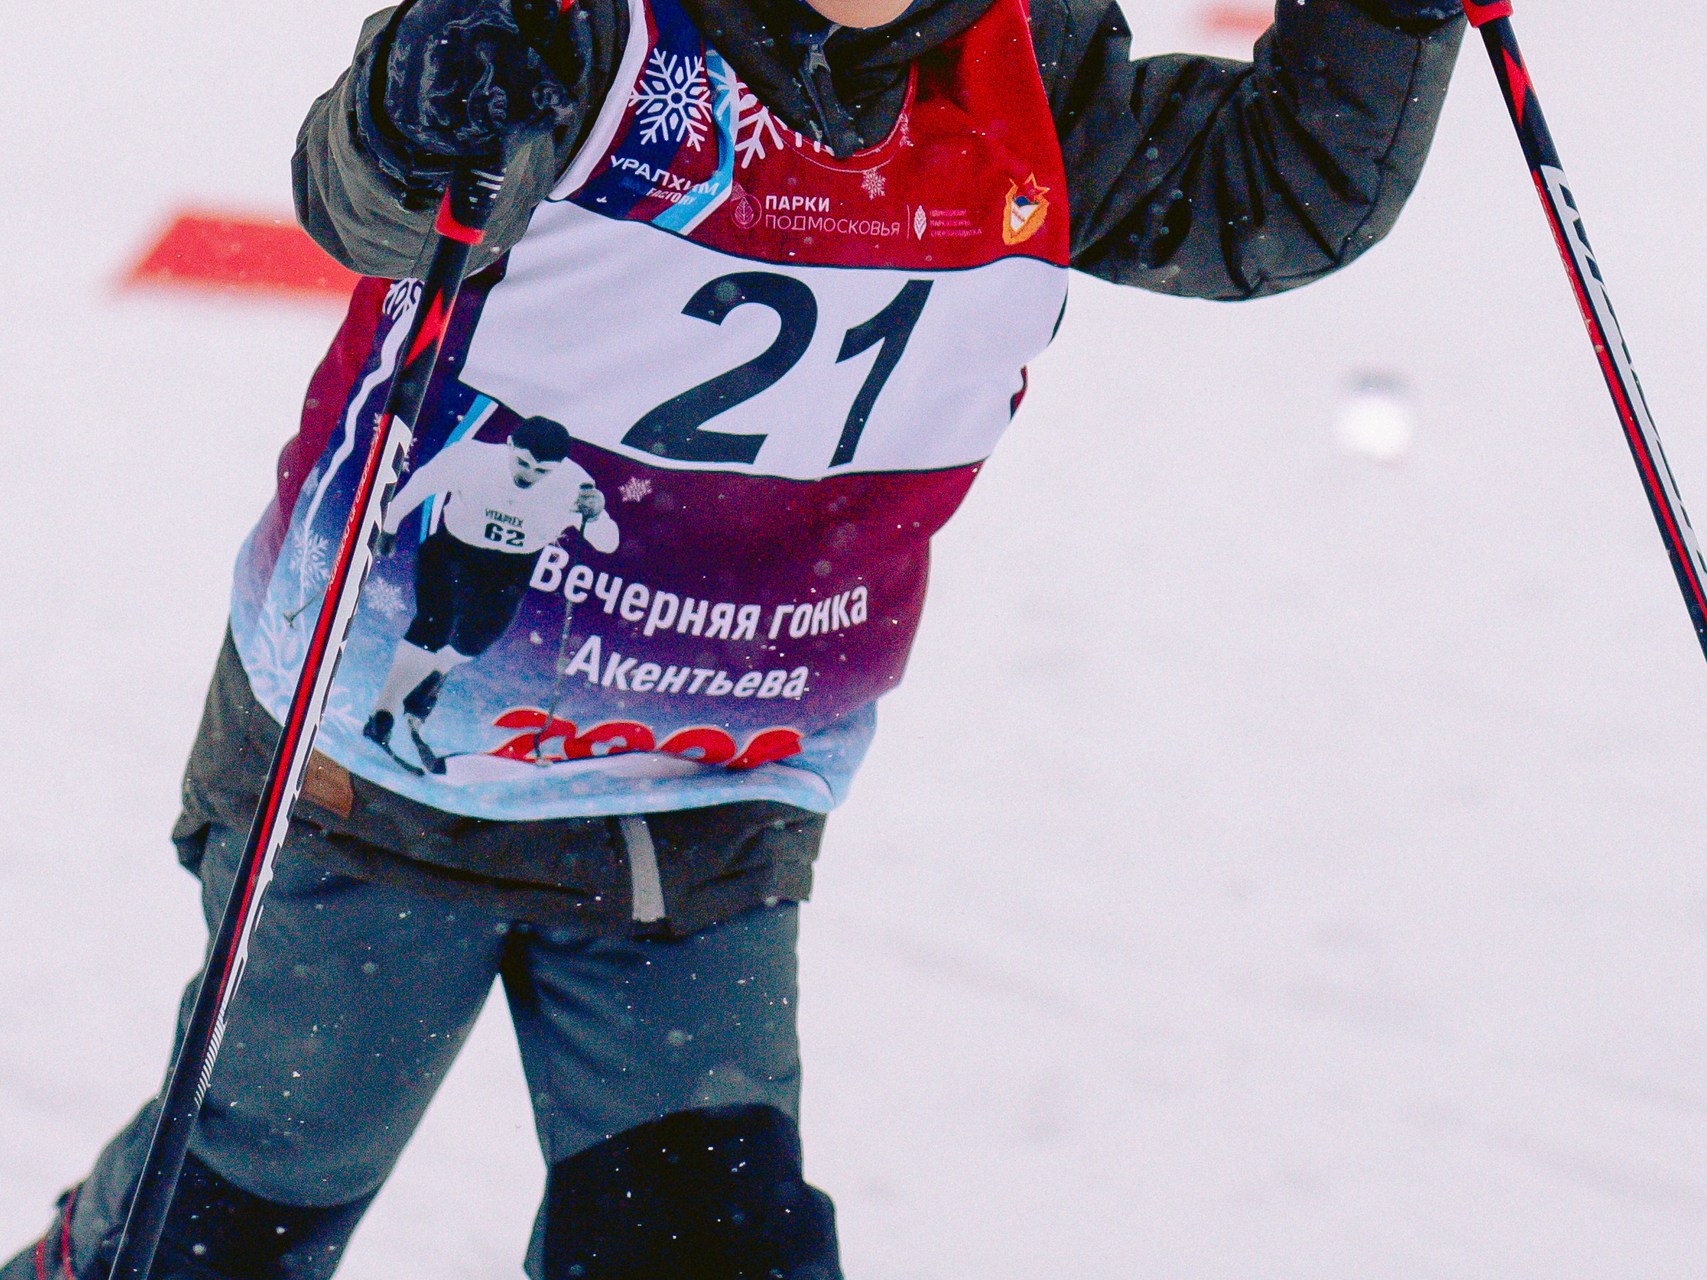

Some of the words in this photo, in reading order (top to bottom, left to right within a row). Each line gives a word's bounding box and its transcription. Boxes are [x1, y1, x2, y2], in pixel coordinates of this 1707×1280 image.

[610, 154, 720, 196] УРАЛХИМ
[645, 187, 697, 206] FACTORY
[765, 195, 830, 213] ПАРКИ
[765, 214, 901, 237] ПОДМОСКОВЬЯ
[620, 271, 934, 469] 21
[484, 522, 525, 548] 62
[529, 543, 762, 641] Вечерняя
[768, 585, 868, 640] гонка
[565, 634, 809, 699] Акентьева
